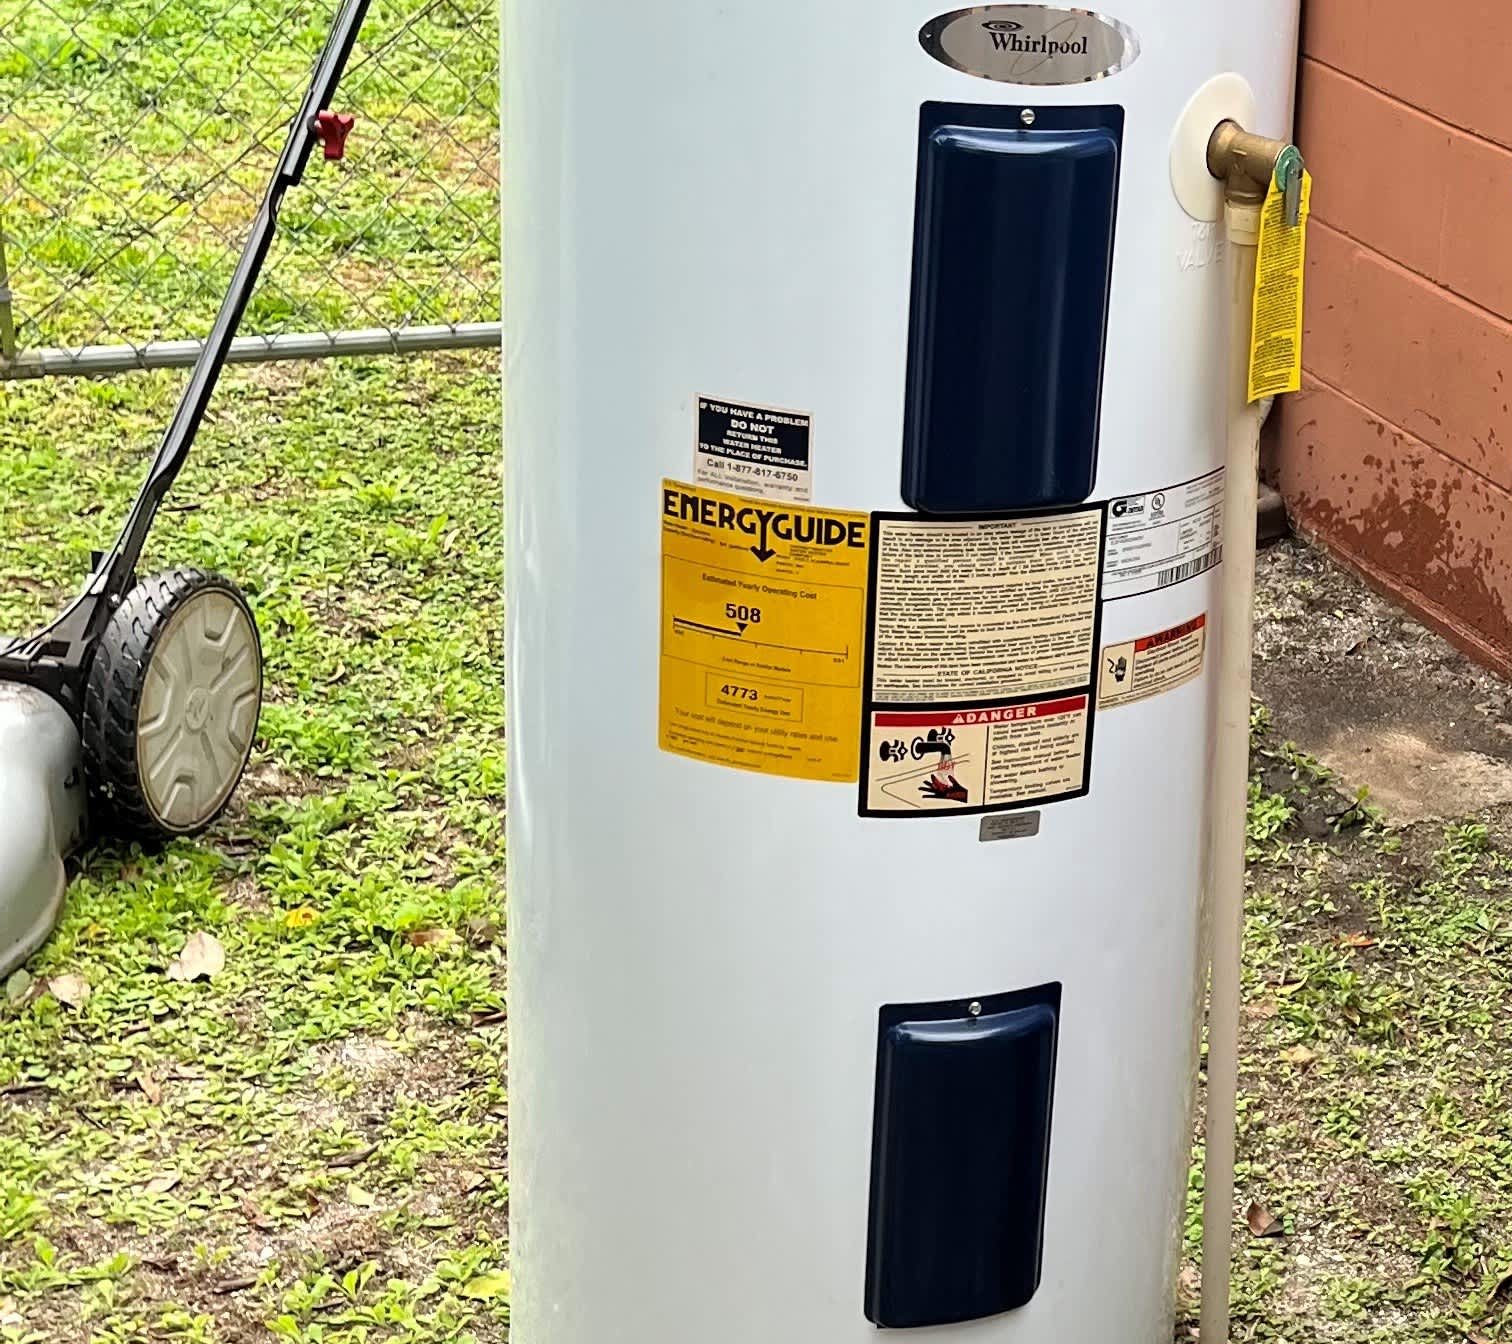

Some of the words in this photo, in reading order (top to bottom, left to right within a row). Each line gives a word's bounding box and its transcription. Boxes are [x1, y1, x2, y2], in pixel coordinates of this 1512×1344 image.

[989, 32, 1088, 58] Whirlpool
[709, 404, 728, 413] YOU
[730, 408, 754, 418] HAVE
[765, 414, 808, 427] PROBLEM
[730, 419, 747, 430] DO
[750, 422, 775, 434] NOT
[711, 445, 725, 454] THE
[726, 448, 750, 459] PLACE
[752, 452, 762, 460] OF
[722, 438, 749, 449] WATER
[751, 443, 782, 454] HEATER
[706, 458, 724, 469] Call
[727, 463, 798, 482] 1-877-817-6750
[663, 489, 865, 549] ENERGYGUIDE
[762, 585, 798, 598] Operating
[799, 590, 817, 600] Cost
[725, 603, 761, 623] 508
[721, 685, 758, 700] 4773
[966, 706, 1037, 723] DANGER
